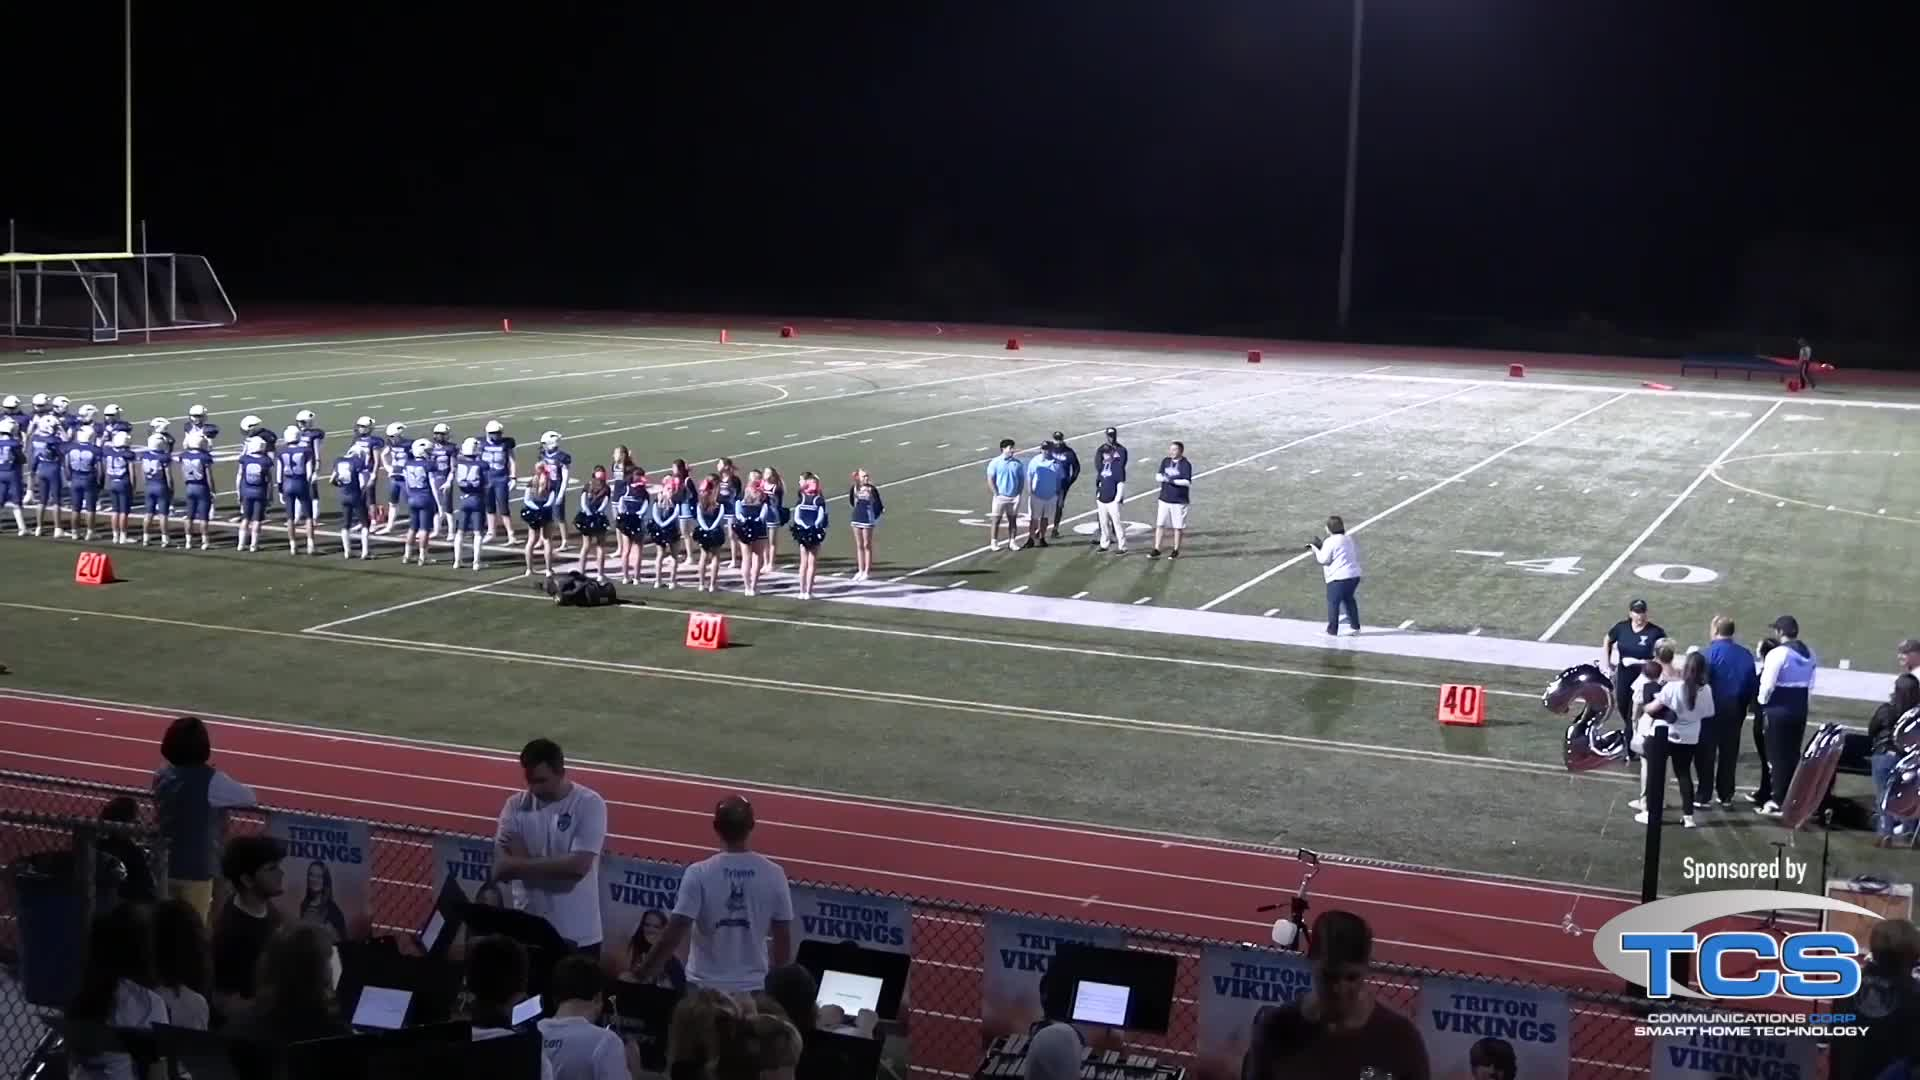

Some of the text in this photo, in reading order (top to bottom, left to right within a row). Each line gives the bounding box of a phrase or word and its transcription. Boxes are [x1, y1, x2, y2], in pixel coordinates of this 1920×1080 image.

[79, 553, 102, 578] 20
[691, 616, 717, 642] 30
[1443, 686, 1477, 716] 40
[287, 841, 362, 864] IKINGS
[608, 883, 679, 911] VIKIN
[816, 902, 888, 924] TRITON
[801, 915, 904, 945] VIKINGS
[1230, 962, 1313, 987] TRITON
[1451, 994, 1537, 1018] TRITON
[1432, 1010, 1557, 1044] VIKINGS
